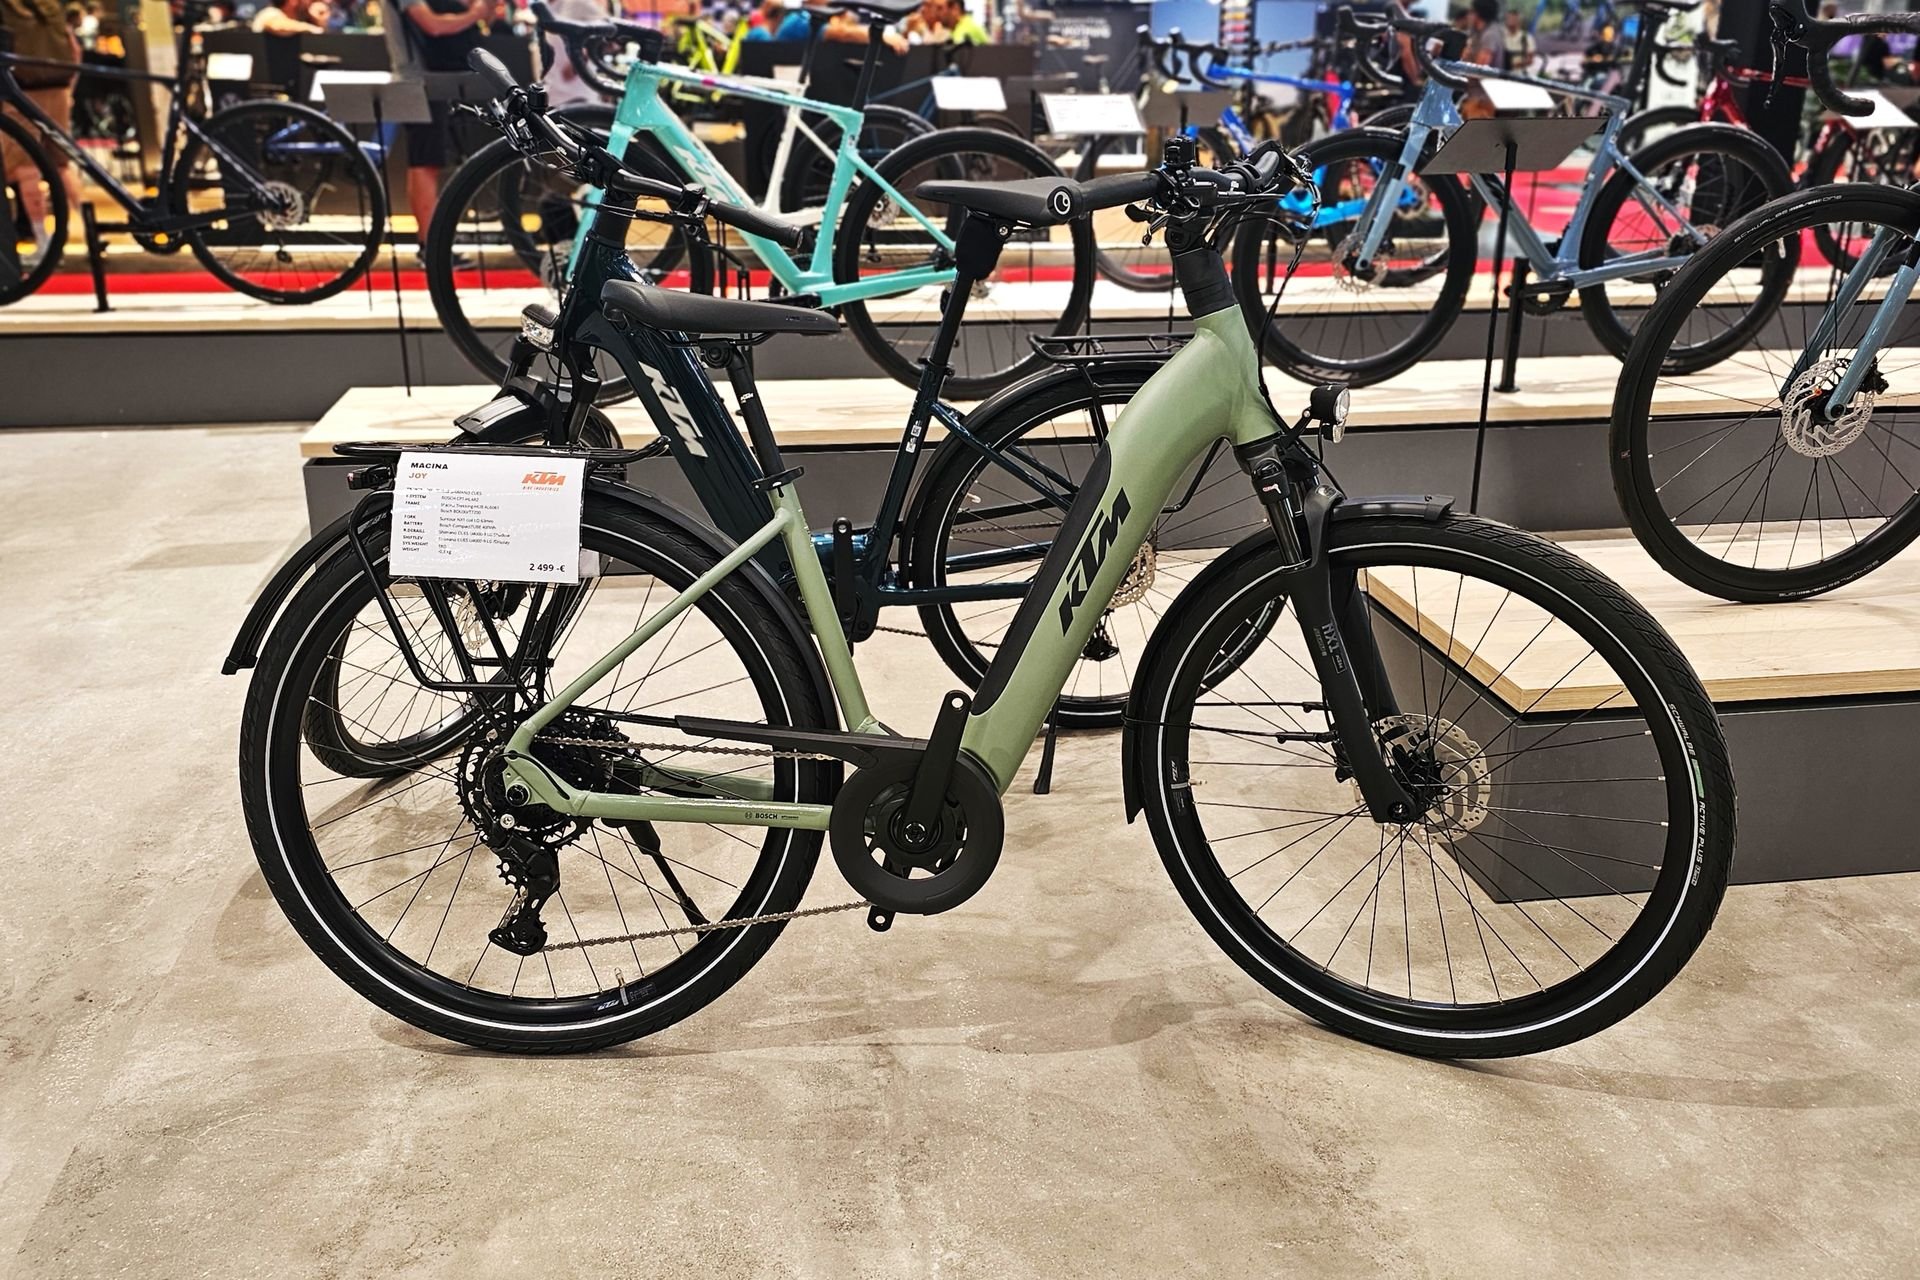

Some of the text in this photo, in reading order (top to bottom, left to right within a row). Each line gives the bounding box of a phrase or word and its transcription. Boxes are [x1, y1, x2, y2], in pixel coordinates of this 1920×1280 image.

[638, 360, 709, 458] KTM
[410, 462, 448, 470] MACINA
[521, 471, 567, 486] KTM
[529, 563, 536, 571] 2
[537, 563, 555, 572] 499
[1058, 486, 1132, 638] KTM
[1668, 703, 1696, 756] SCHWALBE
[754, 812, 778, 820] BOSCH
[1696, 800, 1706, 864] ACTIVE PLUS
